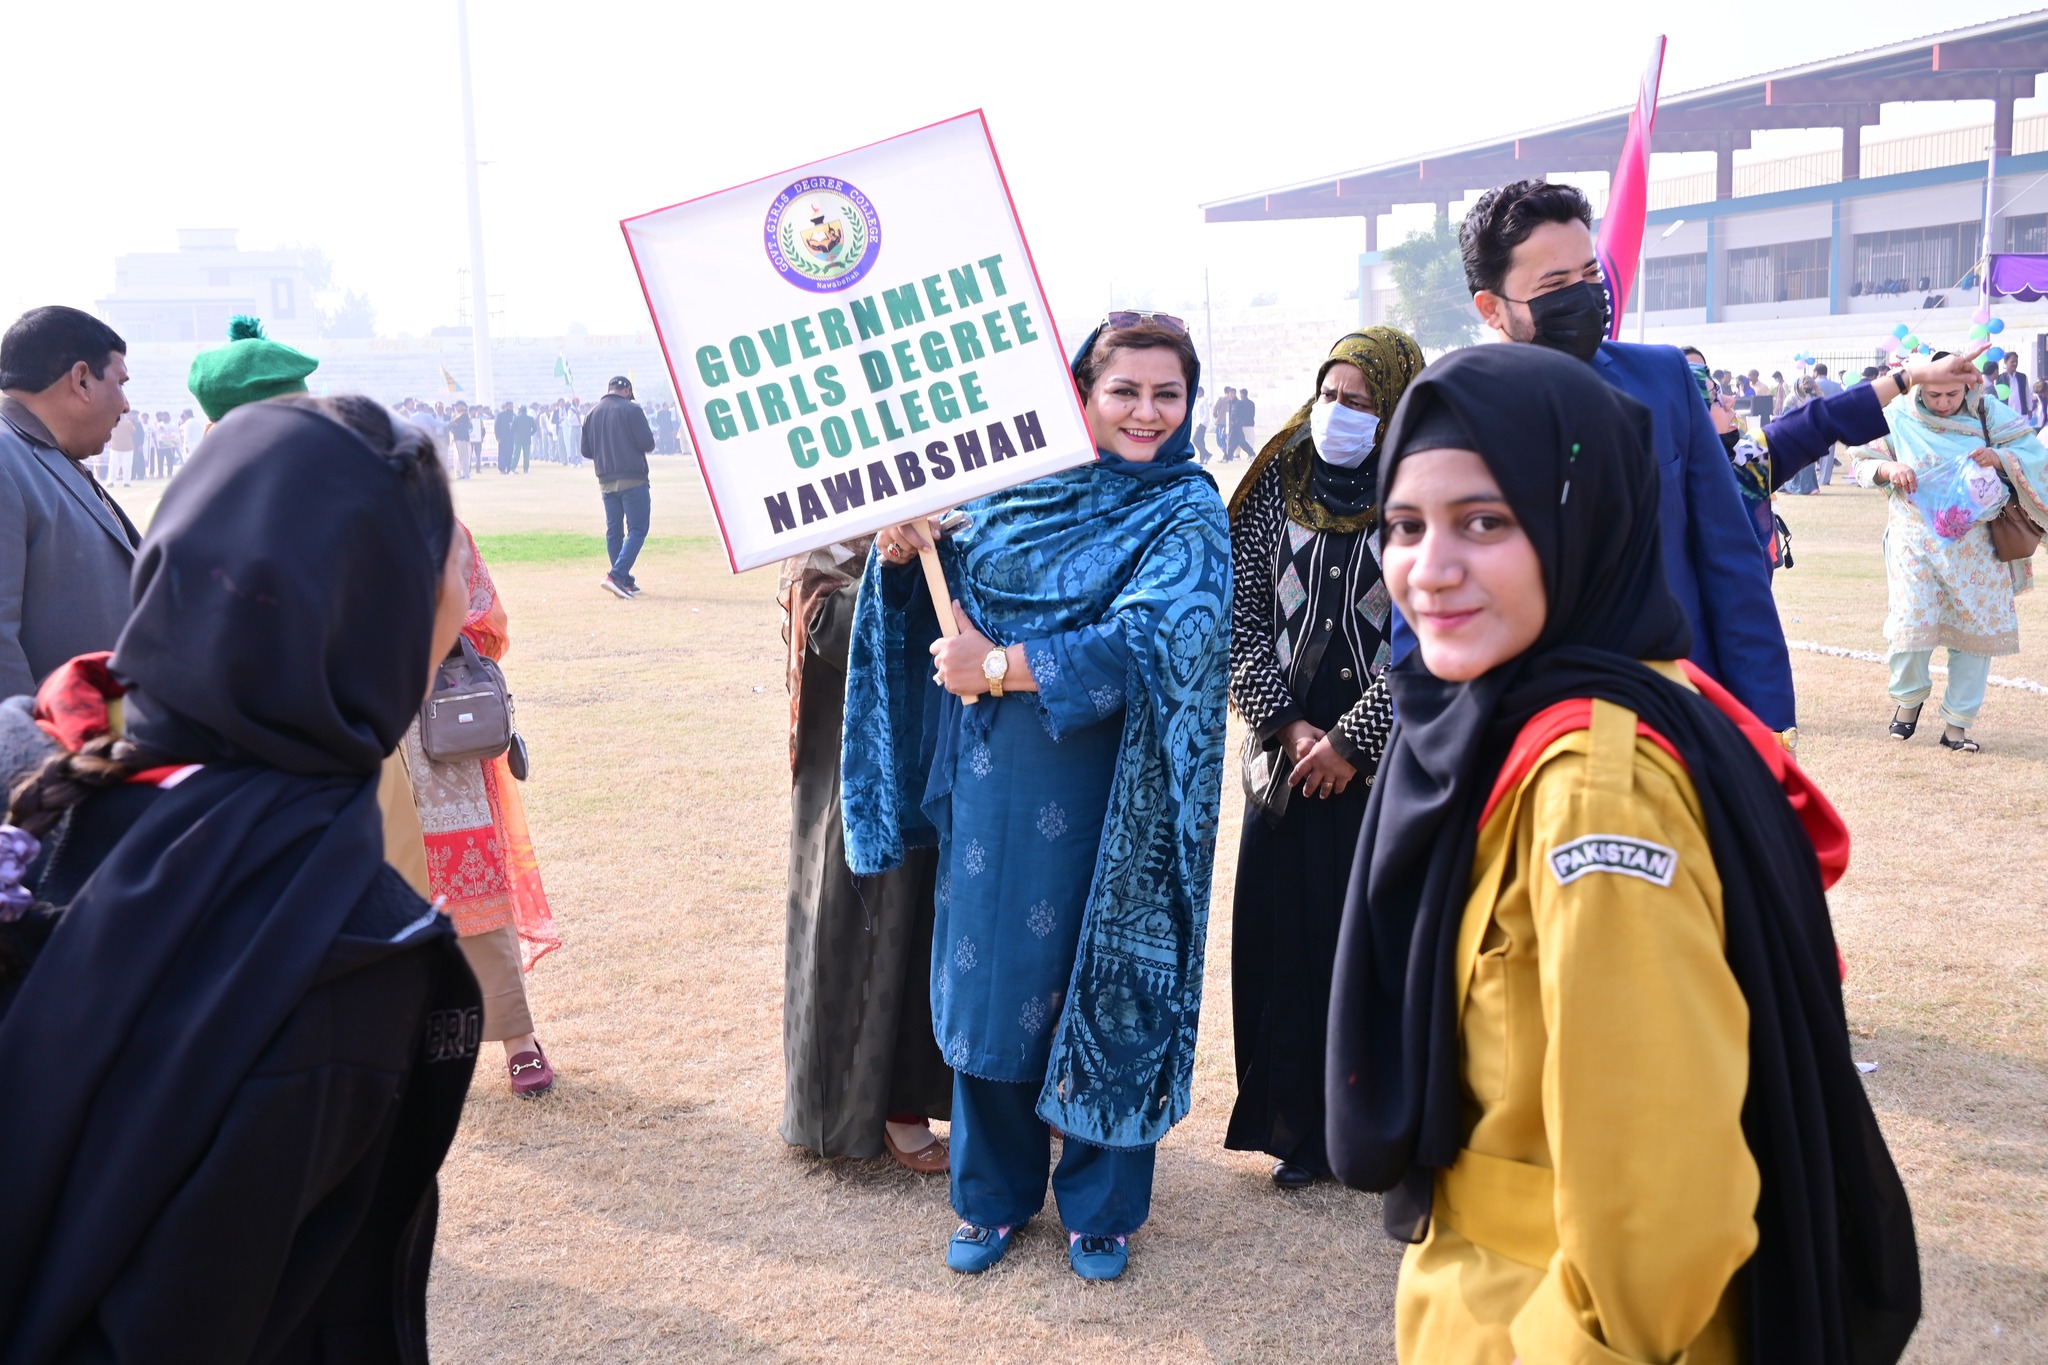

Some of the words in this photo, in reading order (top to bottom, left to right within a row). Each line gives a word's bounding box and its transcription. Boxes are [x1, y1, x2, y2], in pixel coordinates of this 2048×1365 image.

[794, 178, 844, 194] DEGREE
[849, 189, 879, 243] COLLEGE
[695, 254, 1007, 387] GOVERNMENT
[816, 270, 860, 290] Nawabshah
[704, 365, 847, 441] GIRLS
[858, 301, 1039, 393] DEGREE
[787, 371, 989, 469] COLLEGE
[763, 409, 1048, 535] NAWABSHAH
[1554, 842, 1670, 876] PAKISTAN
